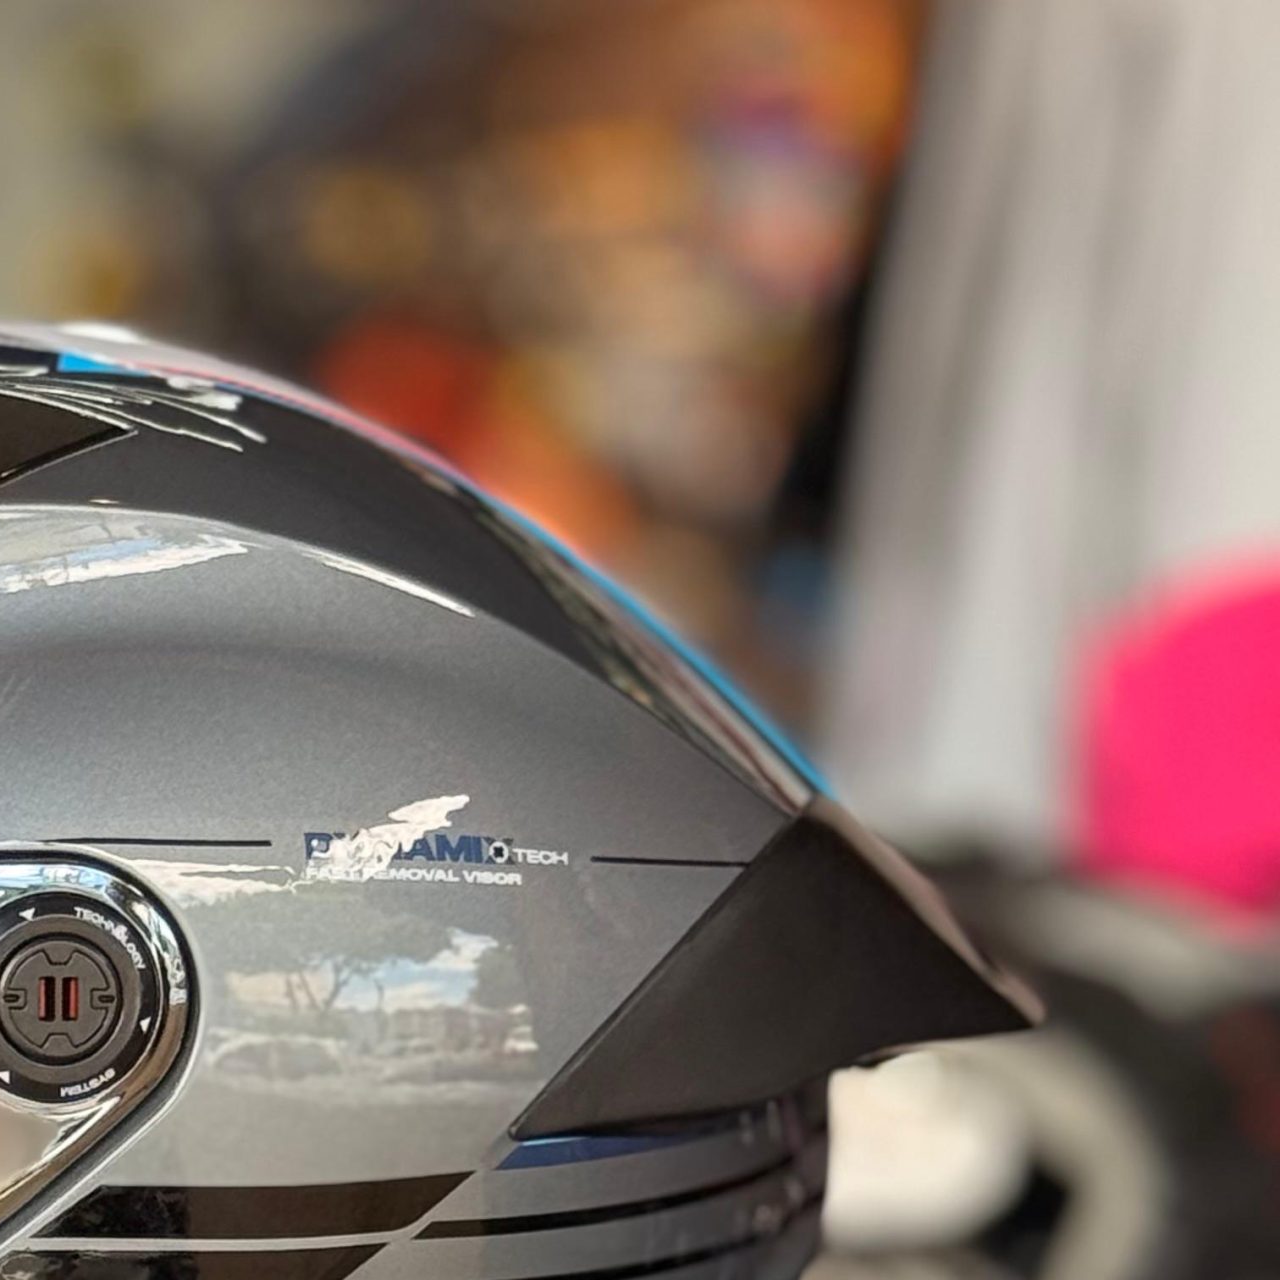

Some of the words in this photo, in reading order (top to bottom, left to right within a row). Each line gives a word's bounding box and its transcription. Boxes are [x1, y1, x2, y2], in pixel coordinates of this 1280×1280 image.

[304, 832, 516, 865] DAMIX
[512, 848, 569, 866] TECH
[463, 871, 523, 886] VISOR
[73, 906, 147, 969] TECHNOLOGY
[60, 1067, 116, 1098] SYSTEM
